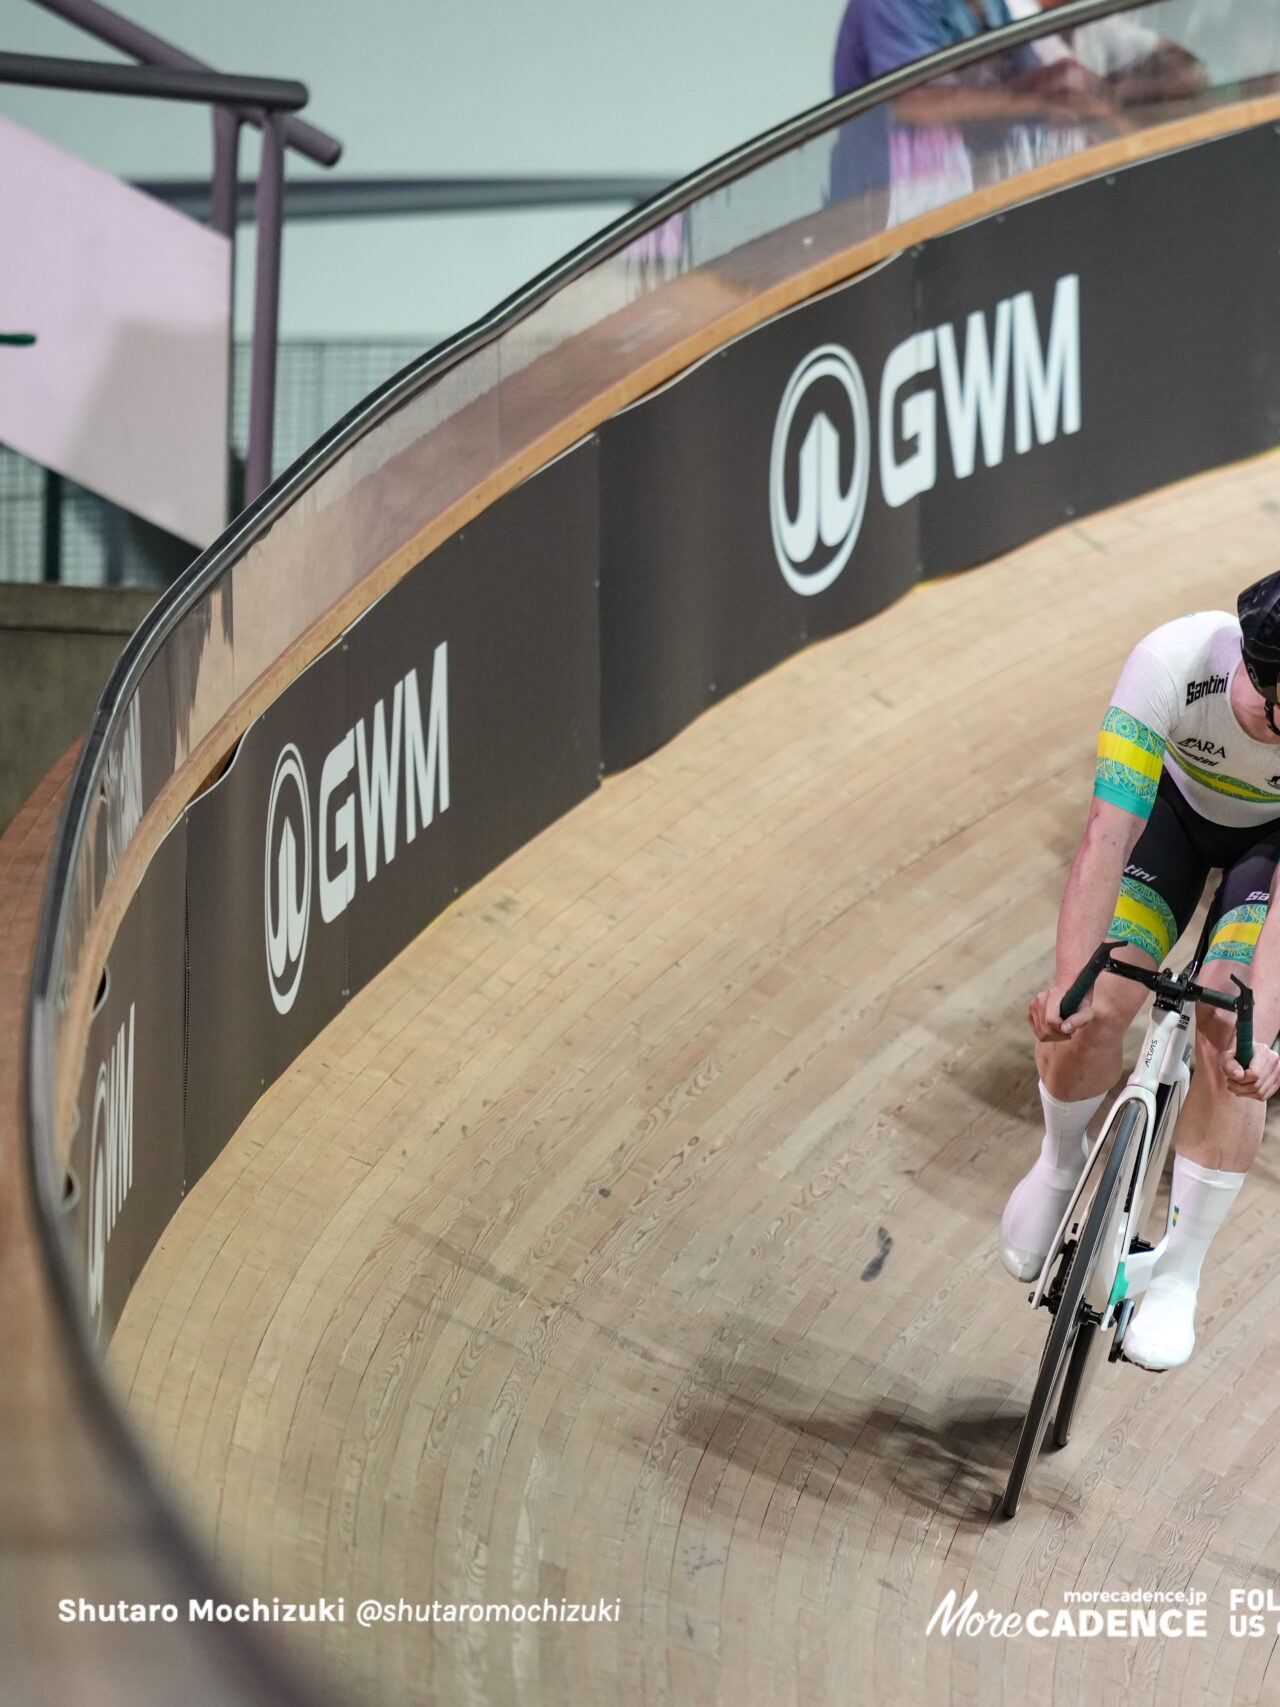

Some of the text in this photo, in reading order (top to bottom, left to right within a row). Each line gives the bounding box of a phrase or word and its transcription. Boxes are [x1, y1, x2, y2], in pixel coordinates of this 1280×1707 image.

[878, 273, 1082, 508] GWM
[319, 641, 450, 924] GWM
[1186, 672, 1230, 706] Santini
